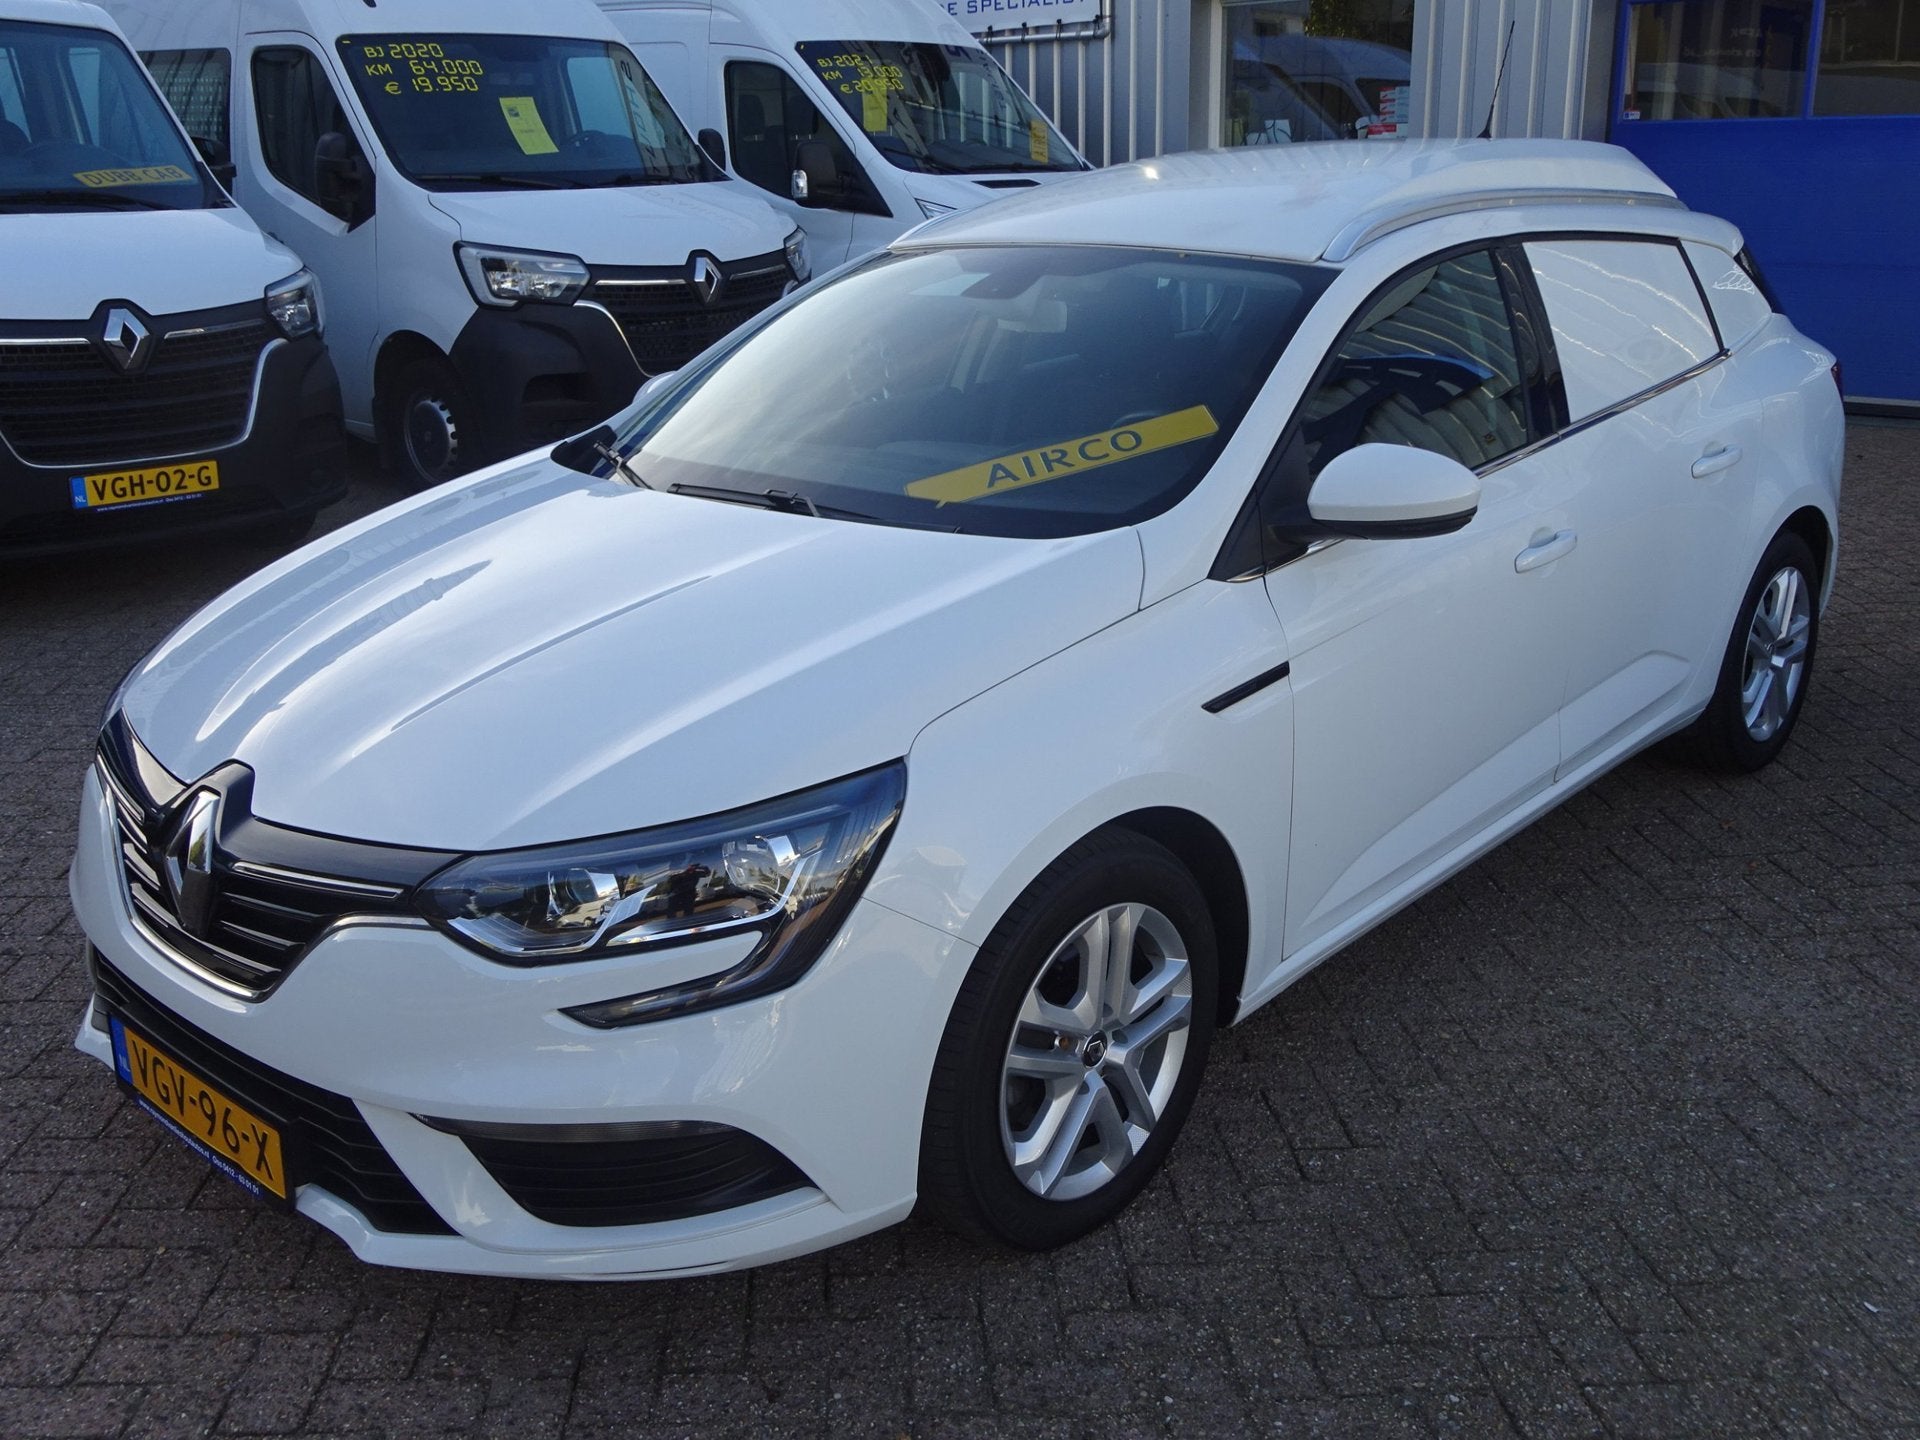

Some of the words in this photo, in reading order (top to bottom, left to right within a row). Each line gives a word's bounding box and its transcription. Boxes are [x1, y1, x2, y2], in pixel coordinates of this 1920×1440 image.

[967, 0, 1085, 14] SPECIA
[364, 46, 385, 58] BJ
[388, 43, 444, 58] 2020
[365, 63, 393, 76] KM
[409, 59, 484, 75] 64.000
[822, 70, 843, 80] KM
[384, 81, 402, 95] €
[412, 76, 479, 92] 19.950
[82, 170, 142, 185] DUBB
[142, 167, 183, 180] CAB
[986, 430, 1143, 489] AIRCO
[92, 466, 212, 501] VGH-02-G
[75, 495, 86, 503] NL
[132, 1039, 273, 1182] VGV-96-X
